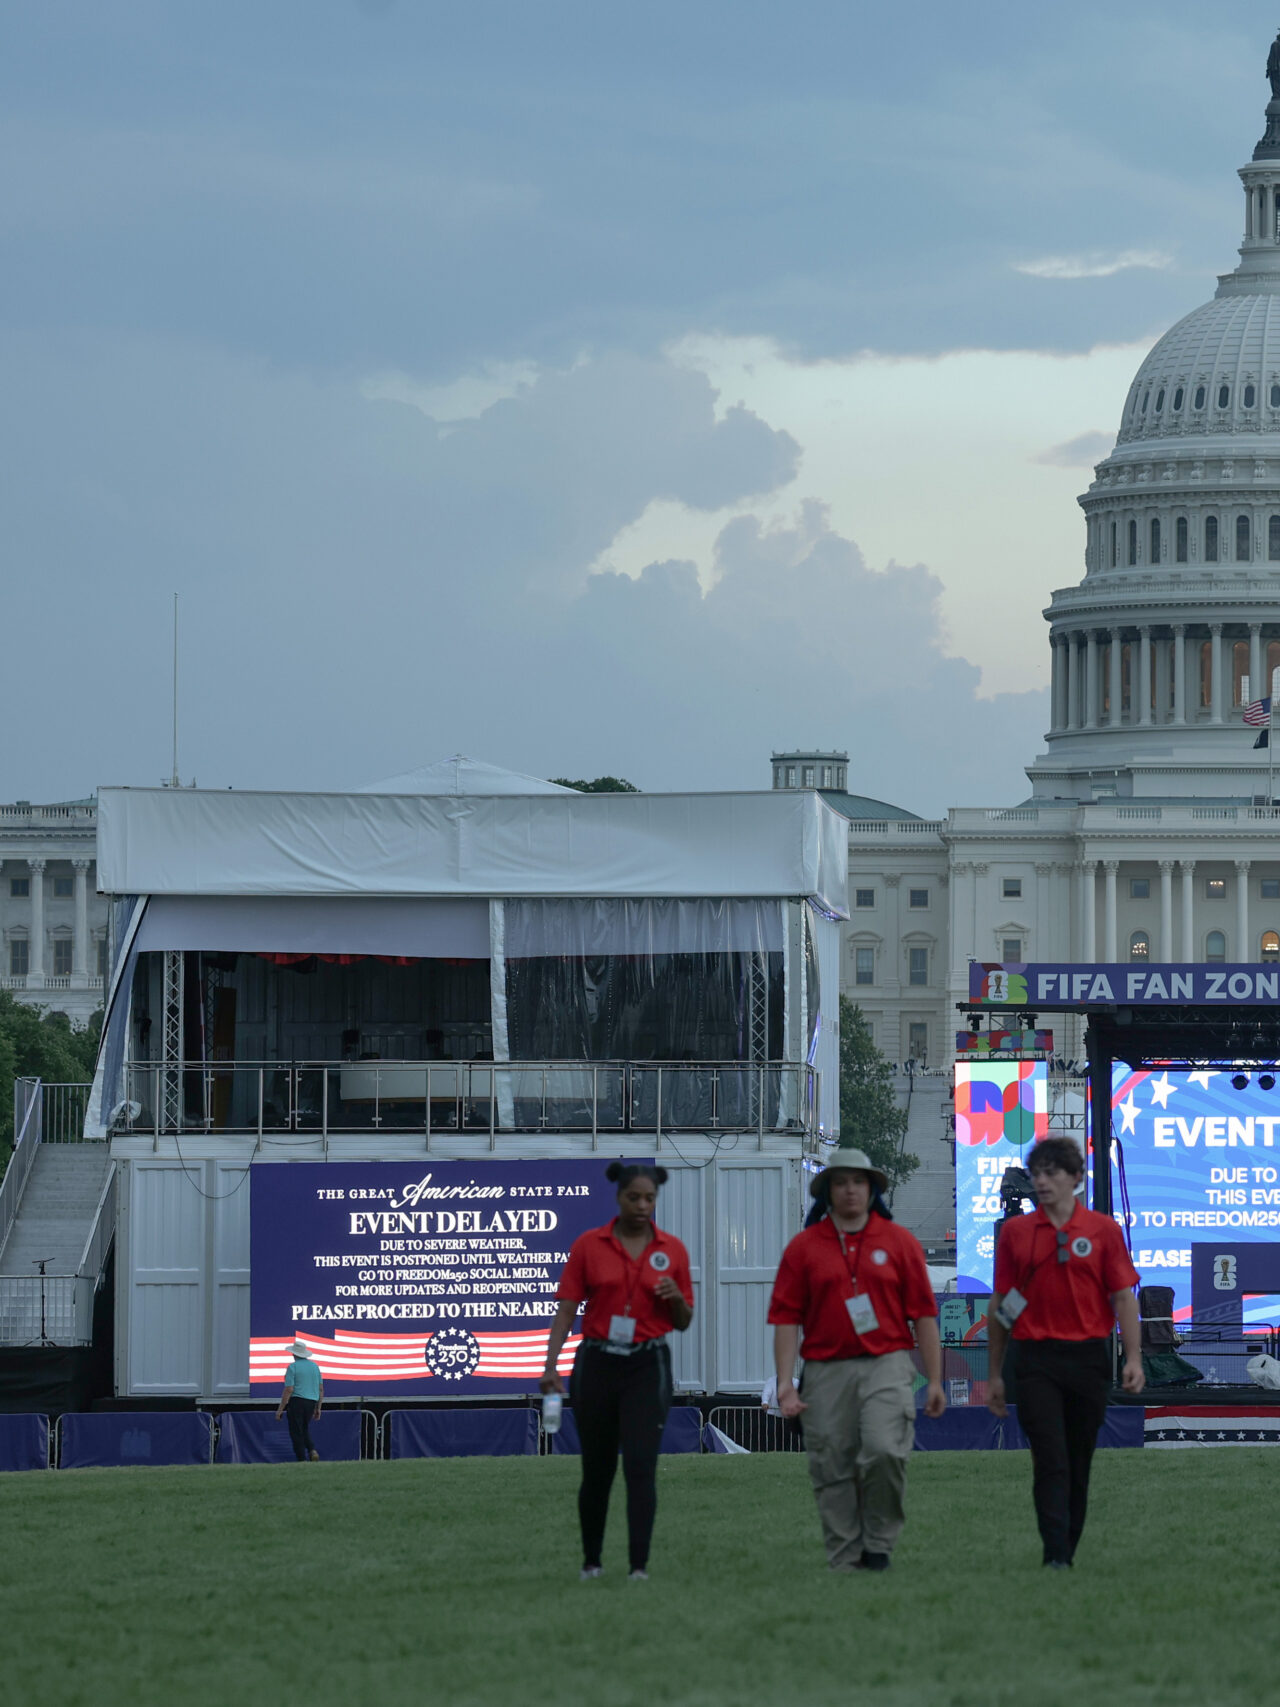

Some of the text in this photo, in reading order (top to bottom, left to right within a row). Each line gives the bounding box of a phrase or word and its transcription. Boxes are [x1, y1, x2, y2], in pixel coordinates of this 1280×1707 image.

[1038, 974, 1115, 1000] FIFA
[1127, 973, 1193, 999] FAN
[977, 1157, 1024, 1175] FIFA
[1210, 1168, 1248, 1183] DUE
[1252, 1167, 1277, 1183] TO
[317, 1173, 590, 1208] THE GREAT American STATE FAIR
[981, 1176, 1003, 1194] FA
[972, 1196, 1033, 1214] ZOE
[1205, 1189, 1247, 1205] THIS
[349, 1209, 558, 1235] EVENT DELAYED
[1113, 1211, 1137, 1227] GO
[1140, 1211, 1167, 1227] TO
[380, 1238, 527, 1251] DUE TO SEVERE WEATHER,
[313, 1256, 340, 1267] THIS
[341, 1255, 380, 1267] EVENT
[381, 1255, 391, 1266] IS
[392, 1253, 460, 1266] POSTPONED
[461, 1254, 496, 1265] UNTIL
[496, 1252, 553, 1264] WEATHER
[1131, 1249, 1192, 1268] LEASE
[358, 1267, 549, 1282] GO TO FREEDOM250 SOCIAL MEDIA
[335, 1281, 561, 1296] FOR MORE UPDATES AND REOPENING TIM
[292, 1304, 354, 1320] PLEASE
[356, 1303, 435, 1319] PROCEED
[437, 1303, 460, 1318] TO
[462, 1302, 497, 1318] THE
[438, 1351, 468, 1367] 250
